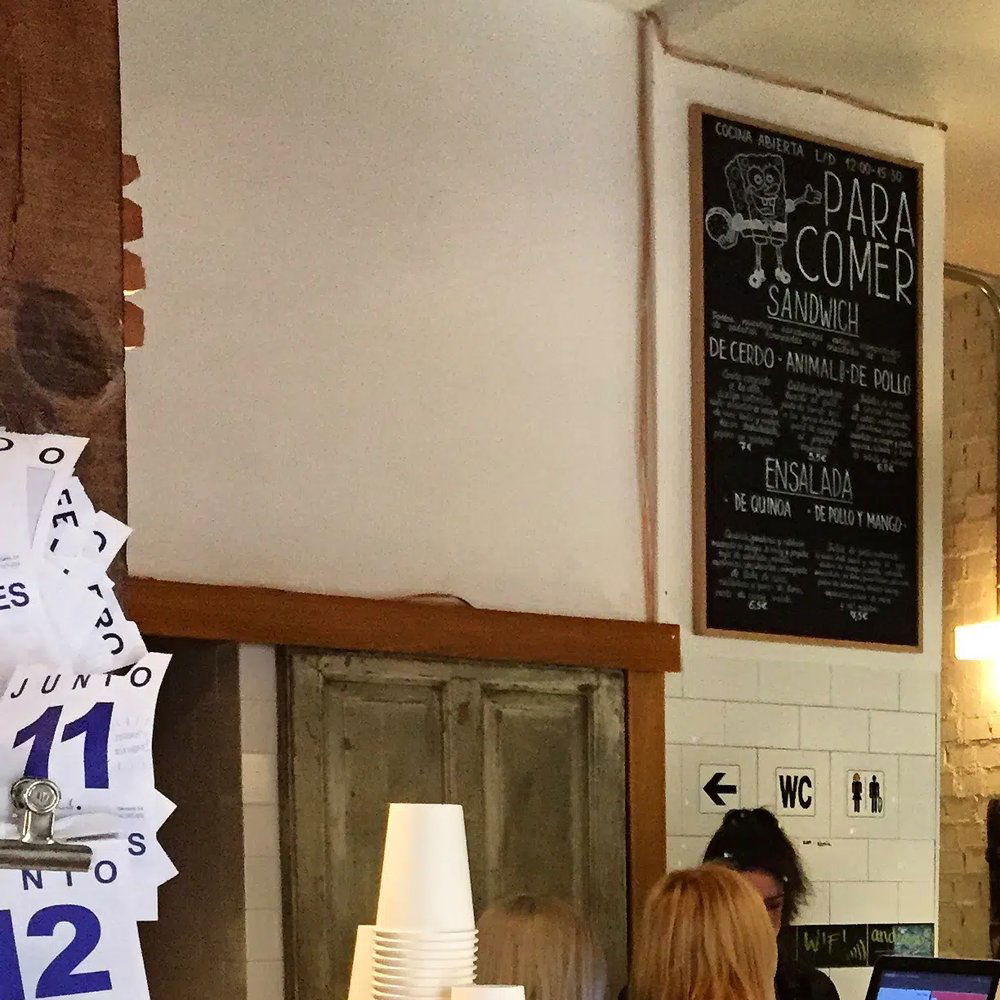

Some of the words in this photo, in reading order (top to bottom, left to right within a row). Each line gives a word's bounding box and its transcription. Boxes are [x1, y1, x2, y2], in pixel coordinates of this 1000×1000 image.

[824, 170, 915, 247] PARA
[796, 225, 912, 305] COMER
[767, 285, 860, 334] SANDWICH
[709, 336, 727, 360] DE
[730, 340, 775, 369] CERDO
[850, 363, 867, 387] DE
[874, 368, 911, 396] POLLO
[765, 457, 853, 500] ENSALADA
[734, 492, 746, 512] DE
[750, 495, 792, 518] QUINOA
[814, 504, 826, 522] DE
[828, 506, 855, 526] POLLO
[857, 510, 864, 527] Y
[867, 512, 901, 533] MANGO
[10, 666, 152, 699] JUNIO
[12, 702, 115, 789] 11
[778, 775, 812, 809] WC
